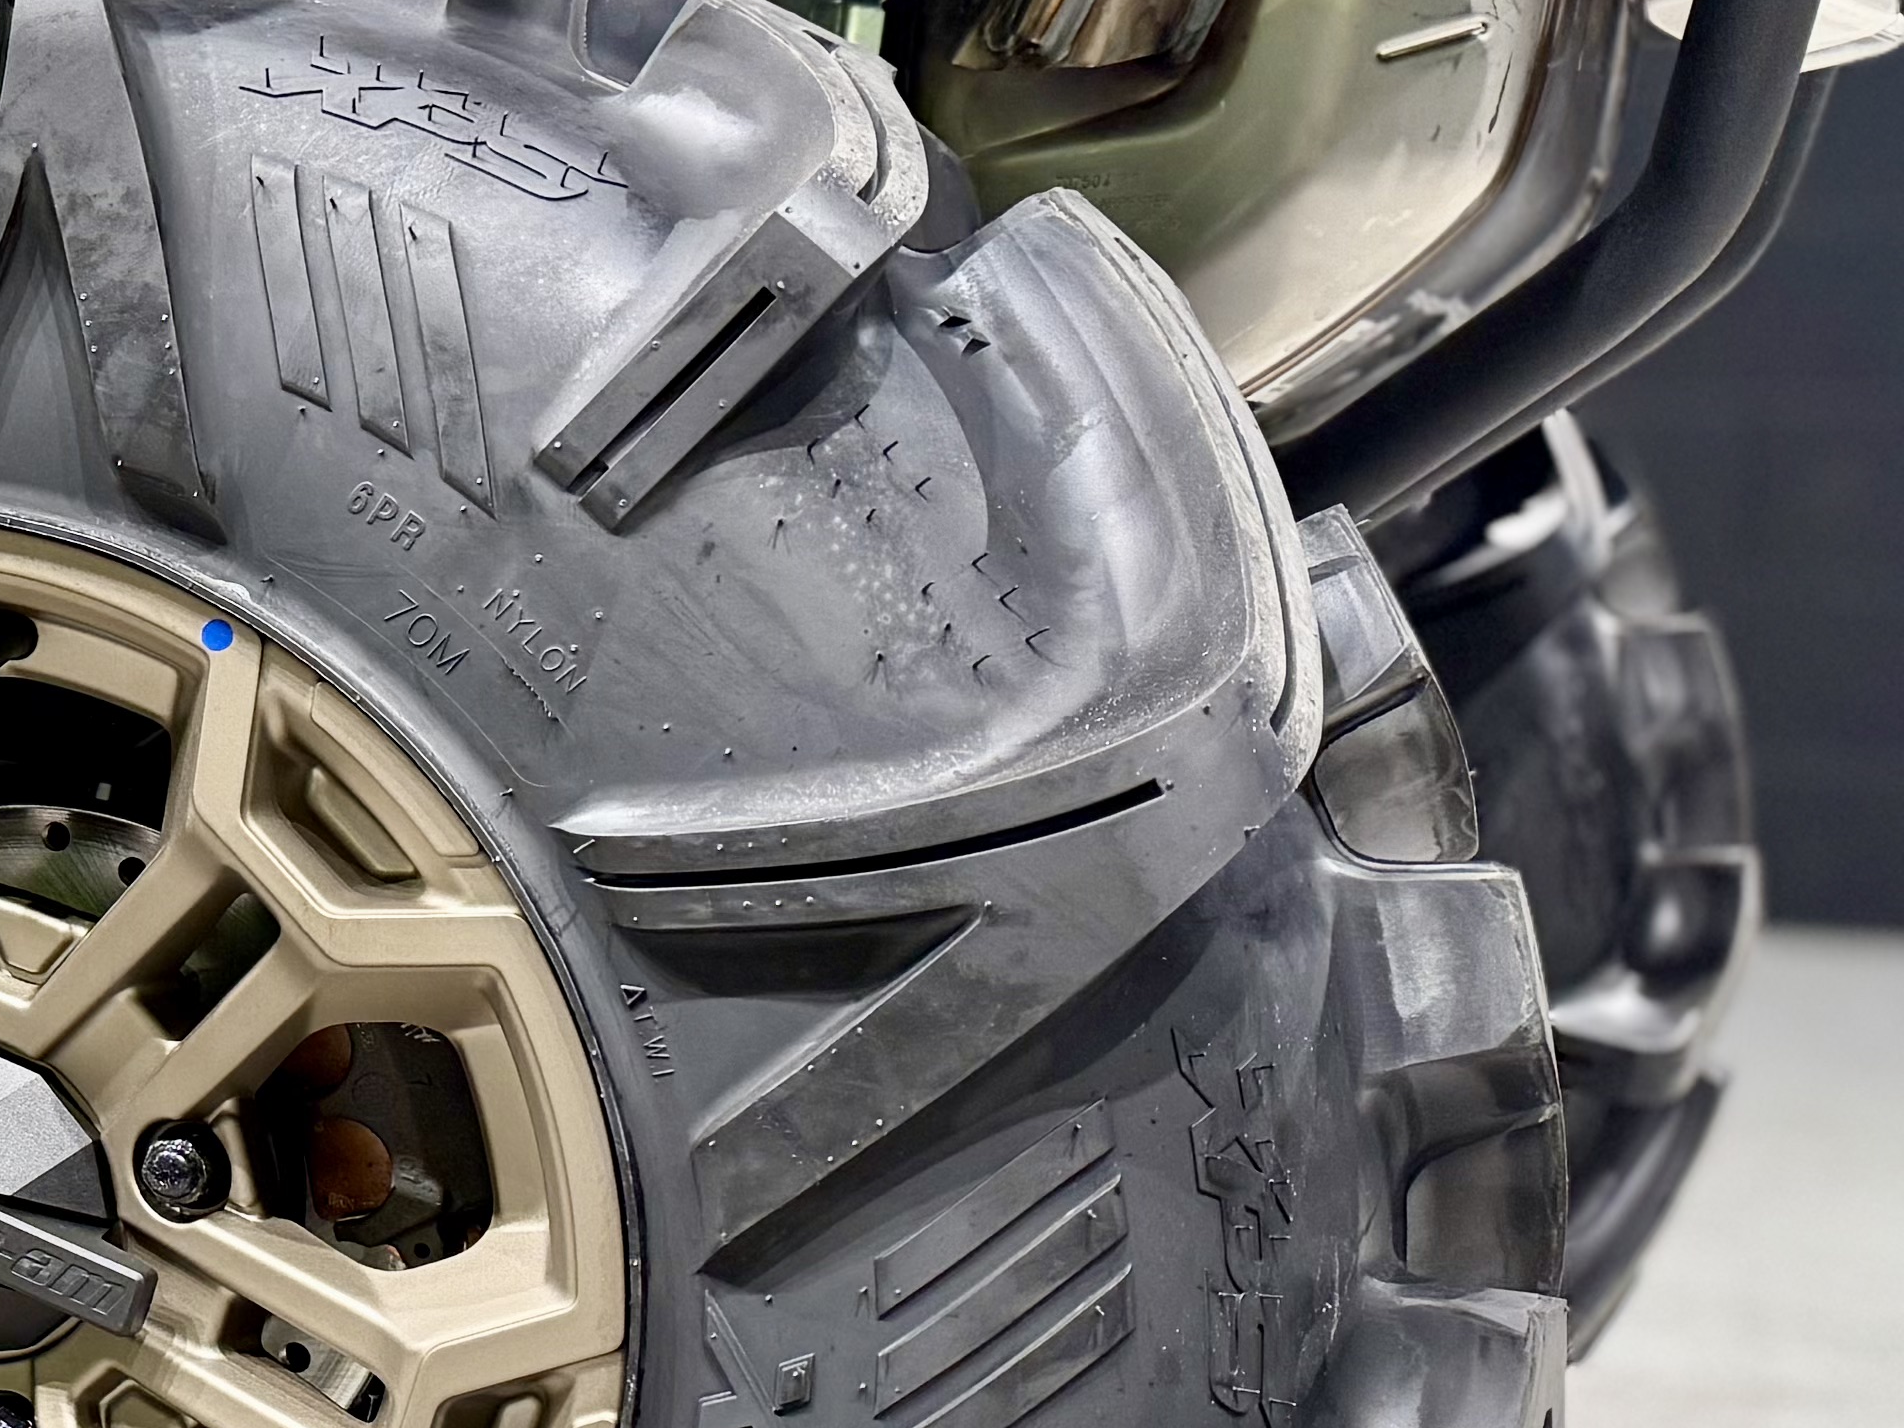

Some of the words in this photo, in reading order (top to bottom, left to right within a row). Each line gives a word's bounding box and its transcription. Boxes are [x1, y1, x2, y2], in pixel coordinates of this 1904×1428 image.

[346, 480, 428, 553] 6PR
[383, 590, 470, 677] 70M
[482, 586, 588, 696] NYLON
